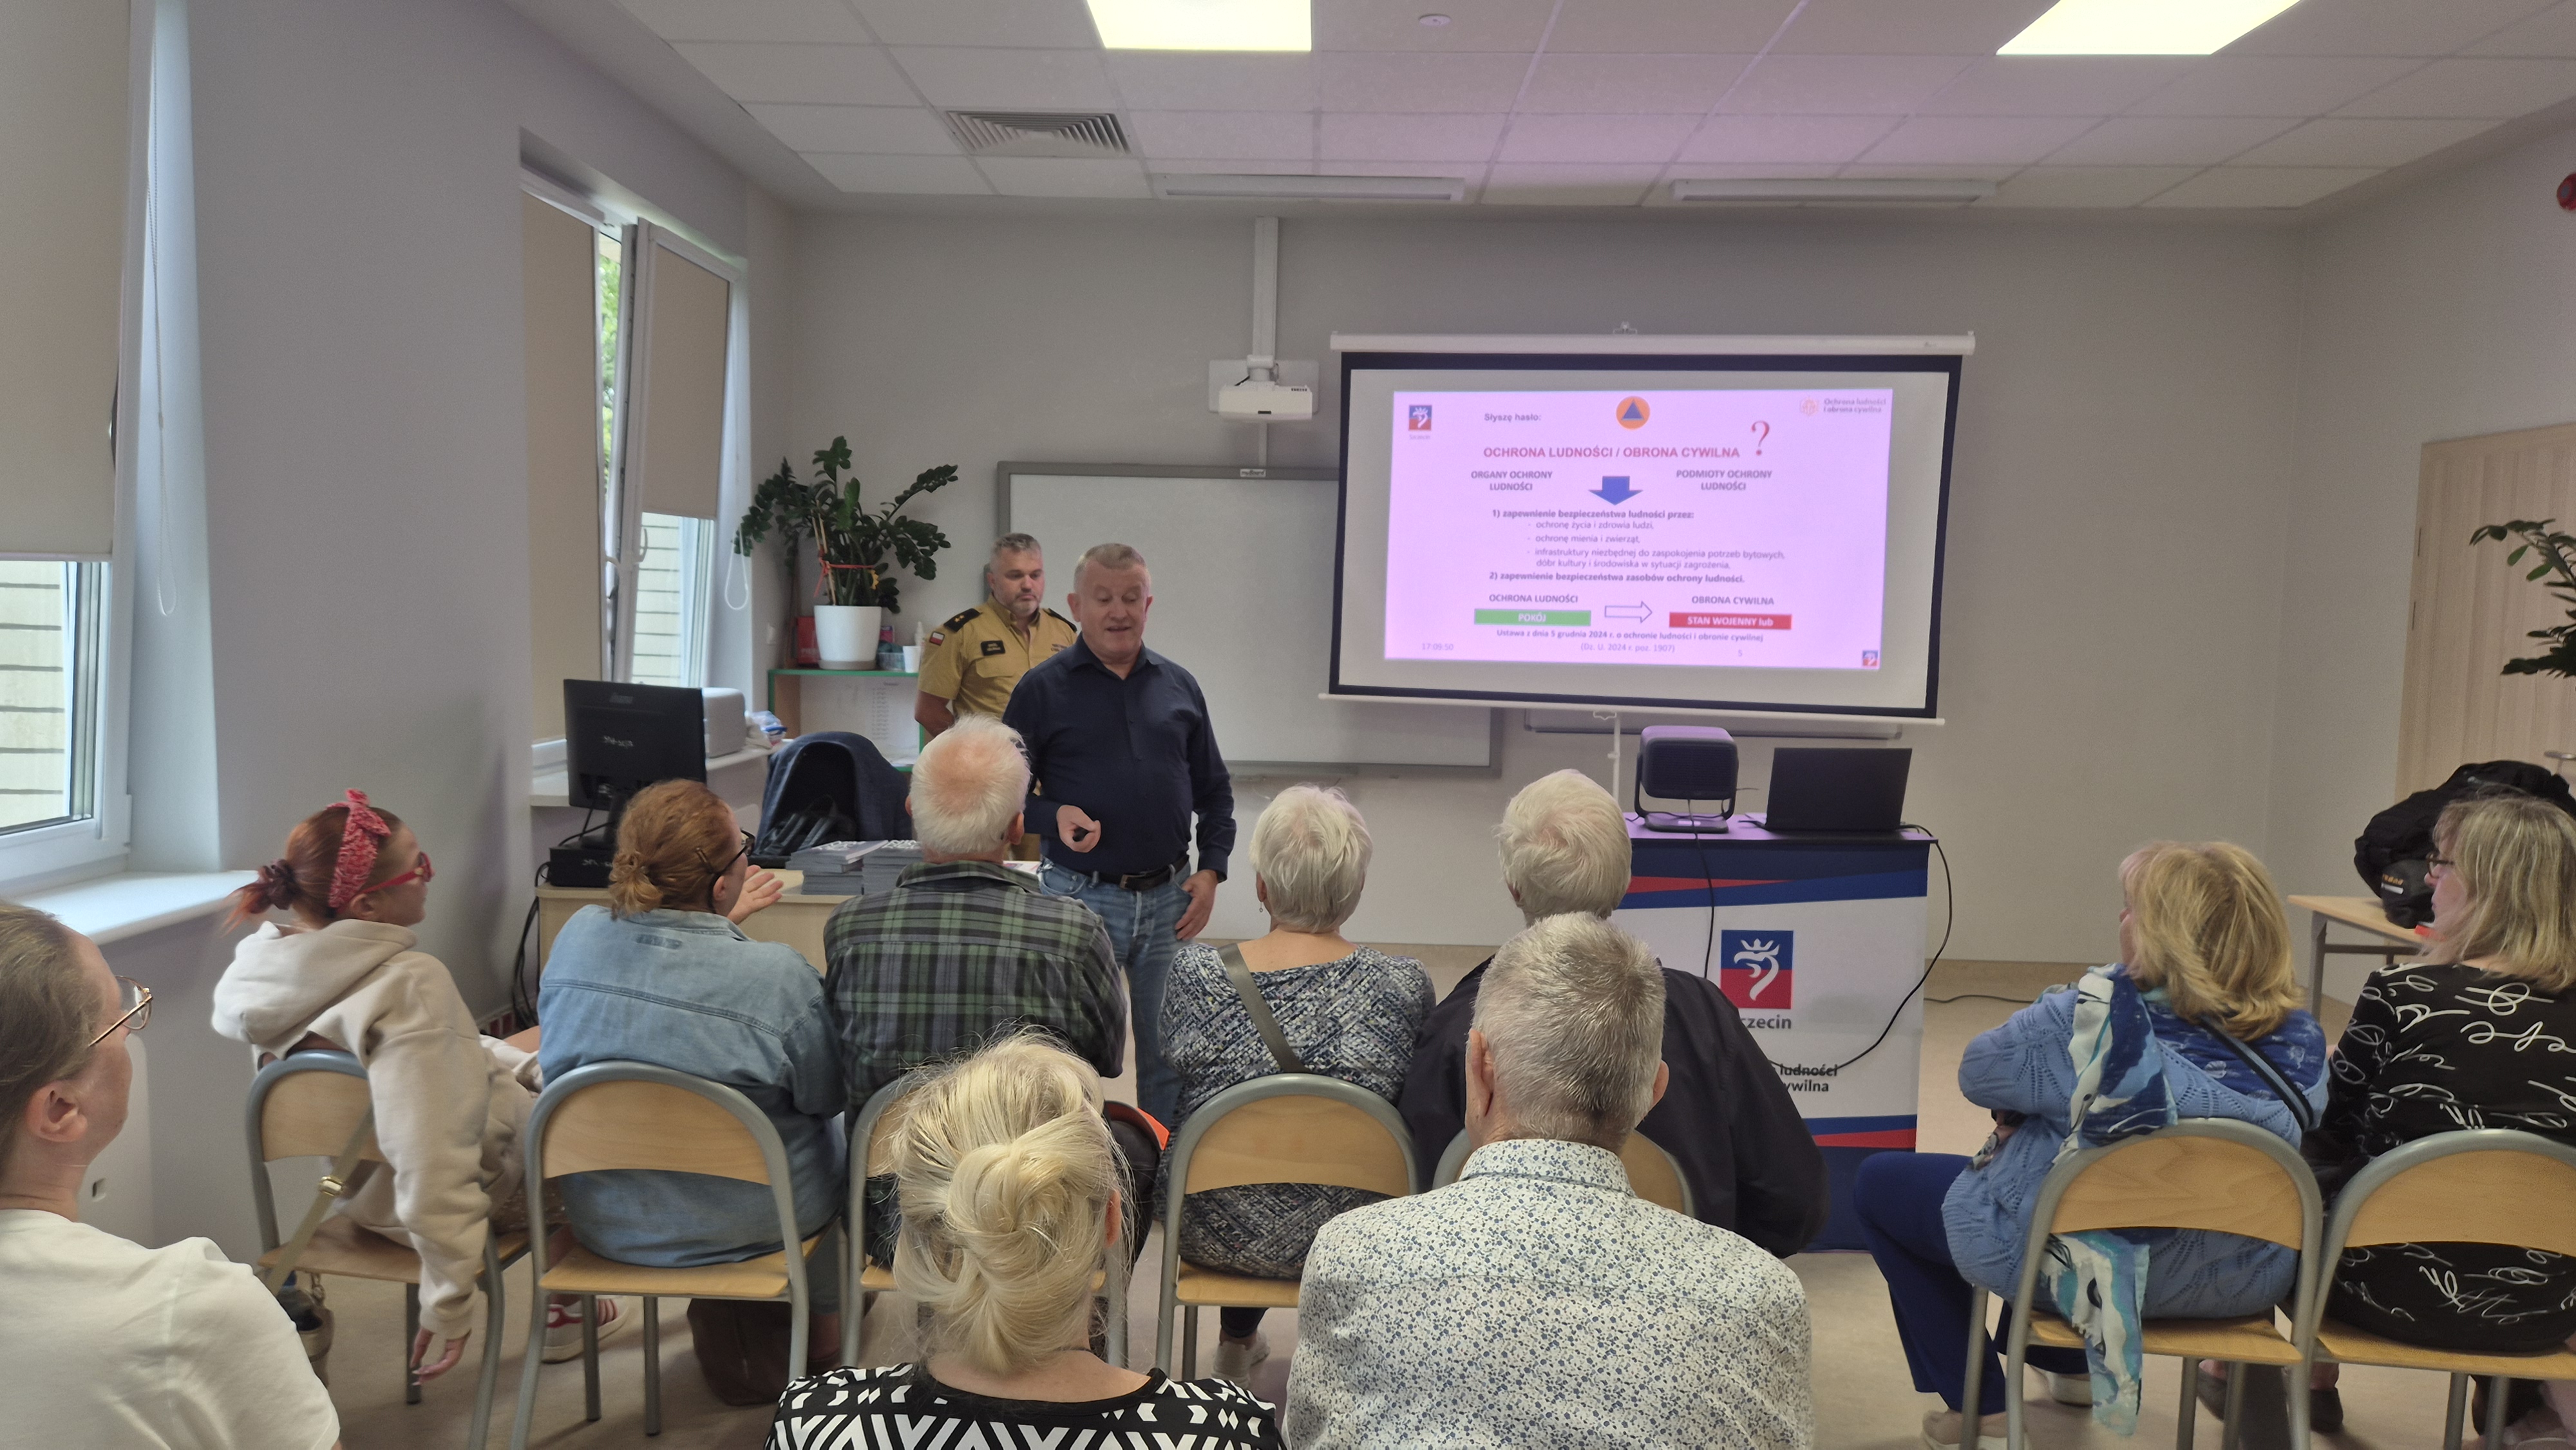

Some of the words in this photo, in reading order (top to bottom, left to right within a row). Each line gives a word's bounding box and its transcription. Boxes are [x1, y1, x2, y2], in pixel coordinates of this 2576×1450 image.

[1483, 447, 1546, 458] OCHRONA
[1548, 445, 1613, 458] LUDNOŚCI
[1622, 447, 1678, 458] OBRONA
[1681, 447, 1740, 458] CYWILNA
[1470, 470, 1508, 479] ORGANY
[1509, 470, 1553, 479] OCHRONY
[1676, 469, 1725, 478] PODMIOTY
[1727, 469, 1773, 479] OCHRONY
[1489, 481, 1533, 491] LUDNOŚCI
[1700, 480, 1747, 491] LUDNOŚCI
[1492, 509, 1501, 518] 1)
[1502, 509, 1557, 520] zapewnienie
[1558, 509, 1627, 520] bezpieczeństwa
[1628, 510, 1665, 519] ludności
[1535, 520, 1569, 530] ochronę
[1571, 521, 1592, 531] życia
[1598, 521, 1631, 529] zdrowia
[1535, 534, 1569, 544] ochronę
[1570, 534, 1598, 543] mienia
[1535, 547, 1589, 558] infrastruktury
[1591, 548, 1636, 559] niezbędnej
[1638, 549, 1650, 557] do
[1651, 549, 1706, 560] zaspokojenia
[1707, 550, 1741, 560] potrzeb
[1536, 558, 1556, 567] dóbr
[1557, 558, 1587, 569] kultury
[1593, 559, 1640, 568] środowiska
[1651, 560, 1682, 570] sytuacji
[1489, 571, 1498, 581] 2)
[1500, 572, 1554, 581] zapewnienie
[1555, 572, 1624, 583] bezpieczeństwa
[1625, 573, 1665, 582] zasobów
[1666, 574, 1703, 585] ochrony
[1488, 594, 1533, 603] OCHRONA
[1534, 594, 1578, 603] LUDNOŚCI
[1691, 596, 1731, 605] OBRONA
[1732, 596, 1775, 605] CYWILNA
[1517, 612, 1547, 623] POKÓJ
[1687, 616, 1710, 626] STAN
[1712, 616, 1757, 626] WOJENNY
[1758, 617, 1774, 626] lub
[1557, 630, 1587, 639] grudnia
[1588, 630, 1608, 639] 2024
[1623, 631, 1658, 639] ochronie
[1659, 632, 1692, 640] ludności
[1698, 632, 1729, 641] obronie
[1730, 634, 1764, 643] cywilnej
[1607, 643, 1627, 652] 2024
[1784, 1079, 1829, 1092] ywilna
